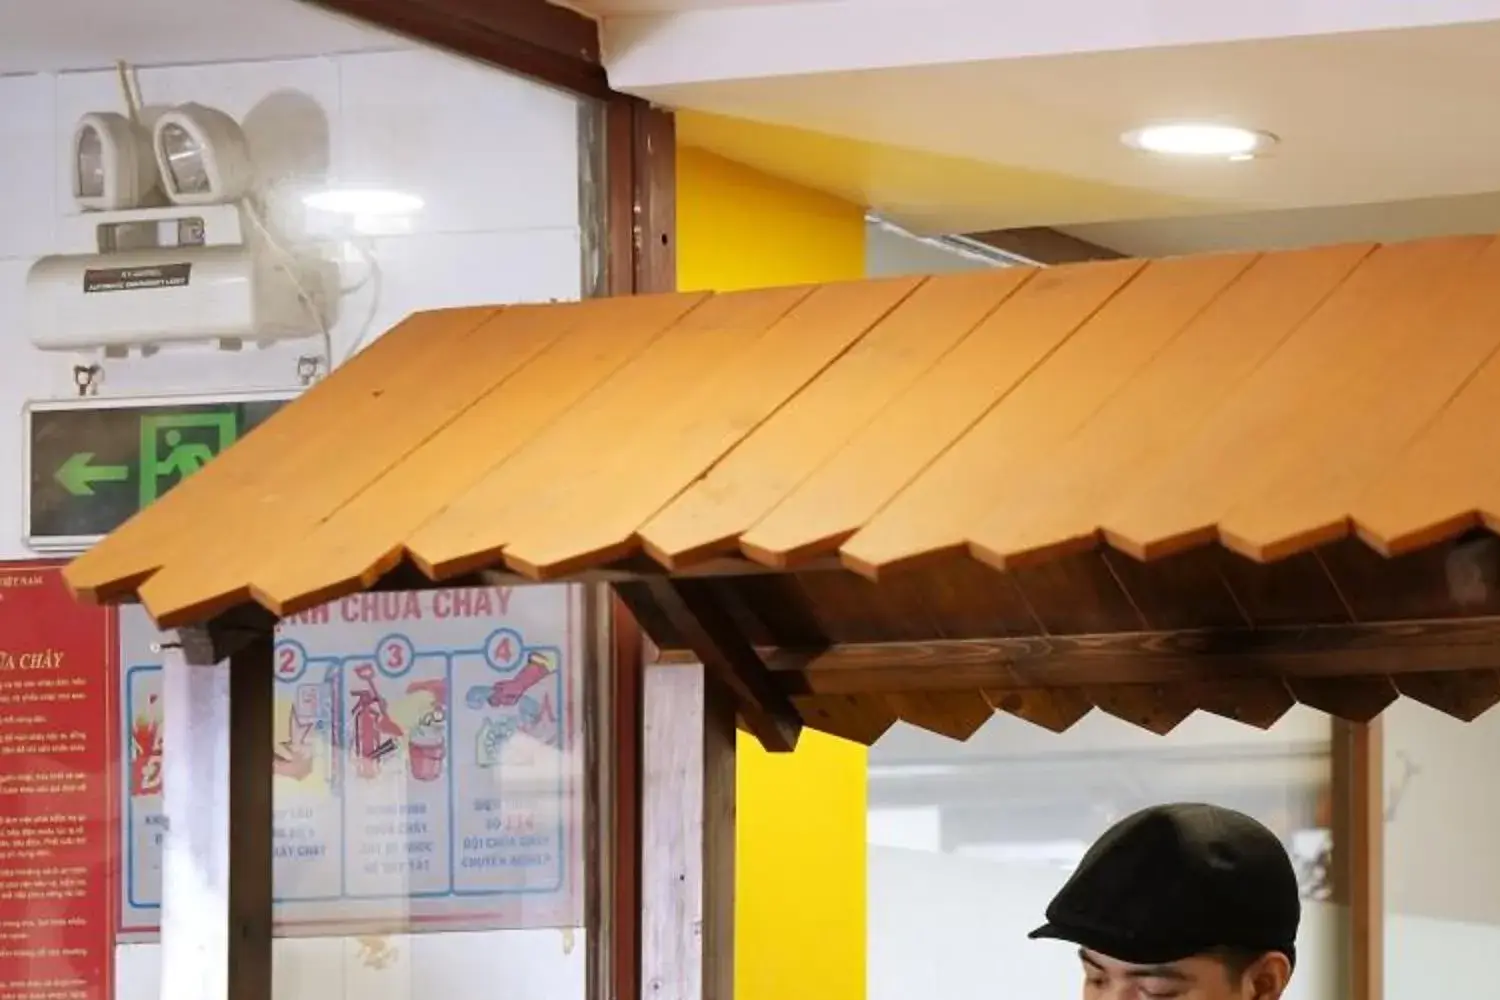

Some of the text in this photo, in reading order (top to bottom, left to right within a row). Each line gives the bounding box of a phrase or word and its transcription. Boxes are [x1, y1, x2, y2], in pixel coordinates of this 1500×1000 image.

[279, 648, 296, 673] 2
[387, 644, 403, 668] 3
[494, 637, 511, 661] 4
